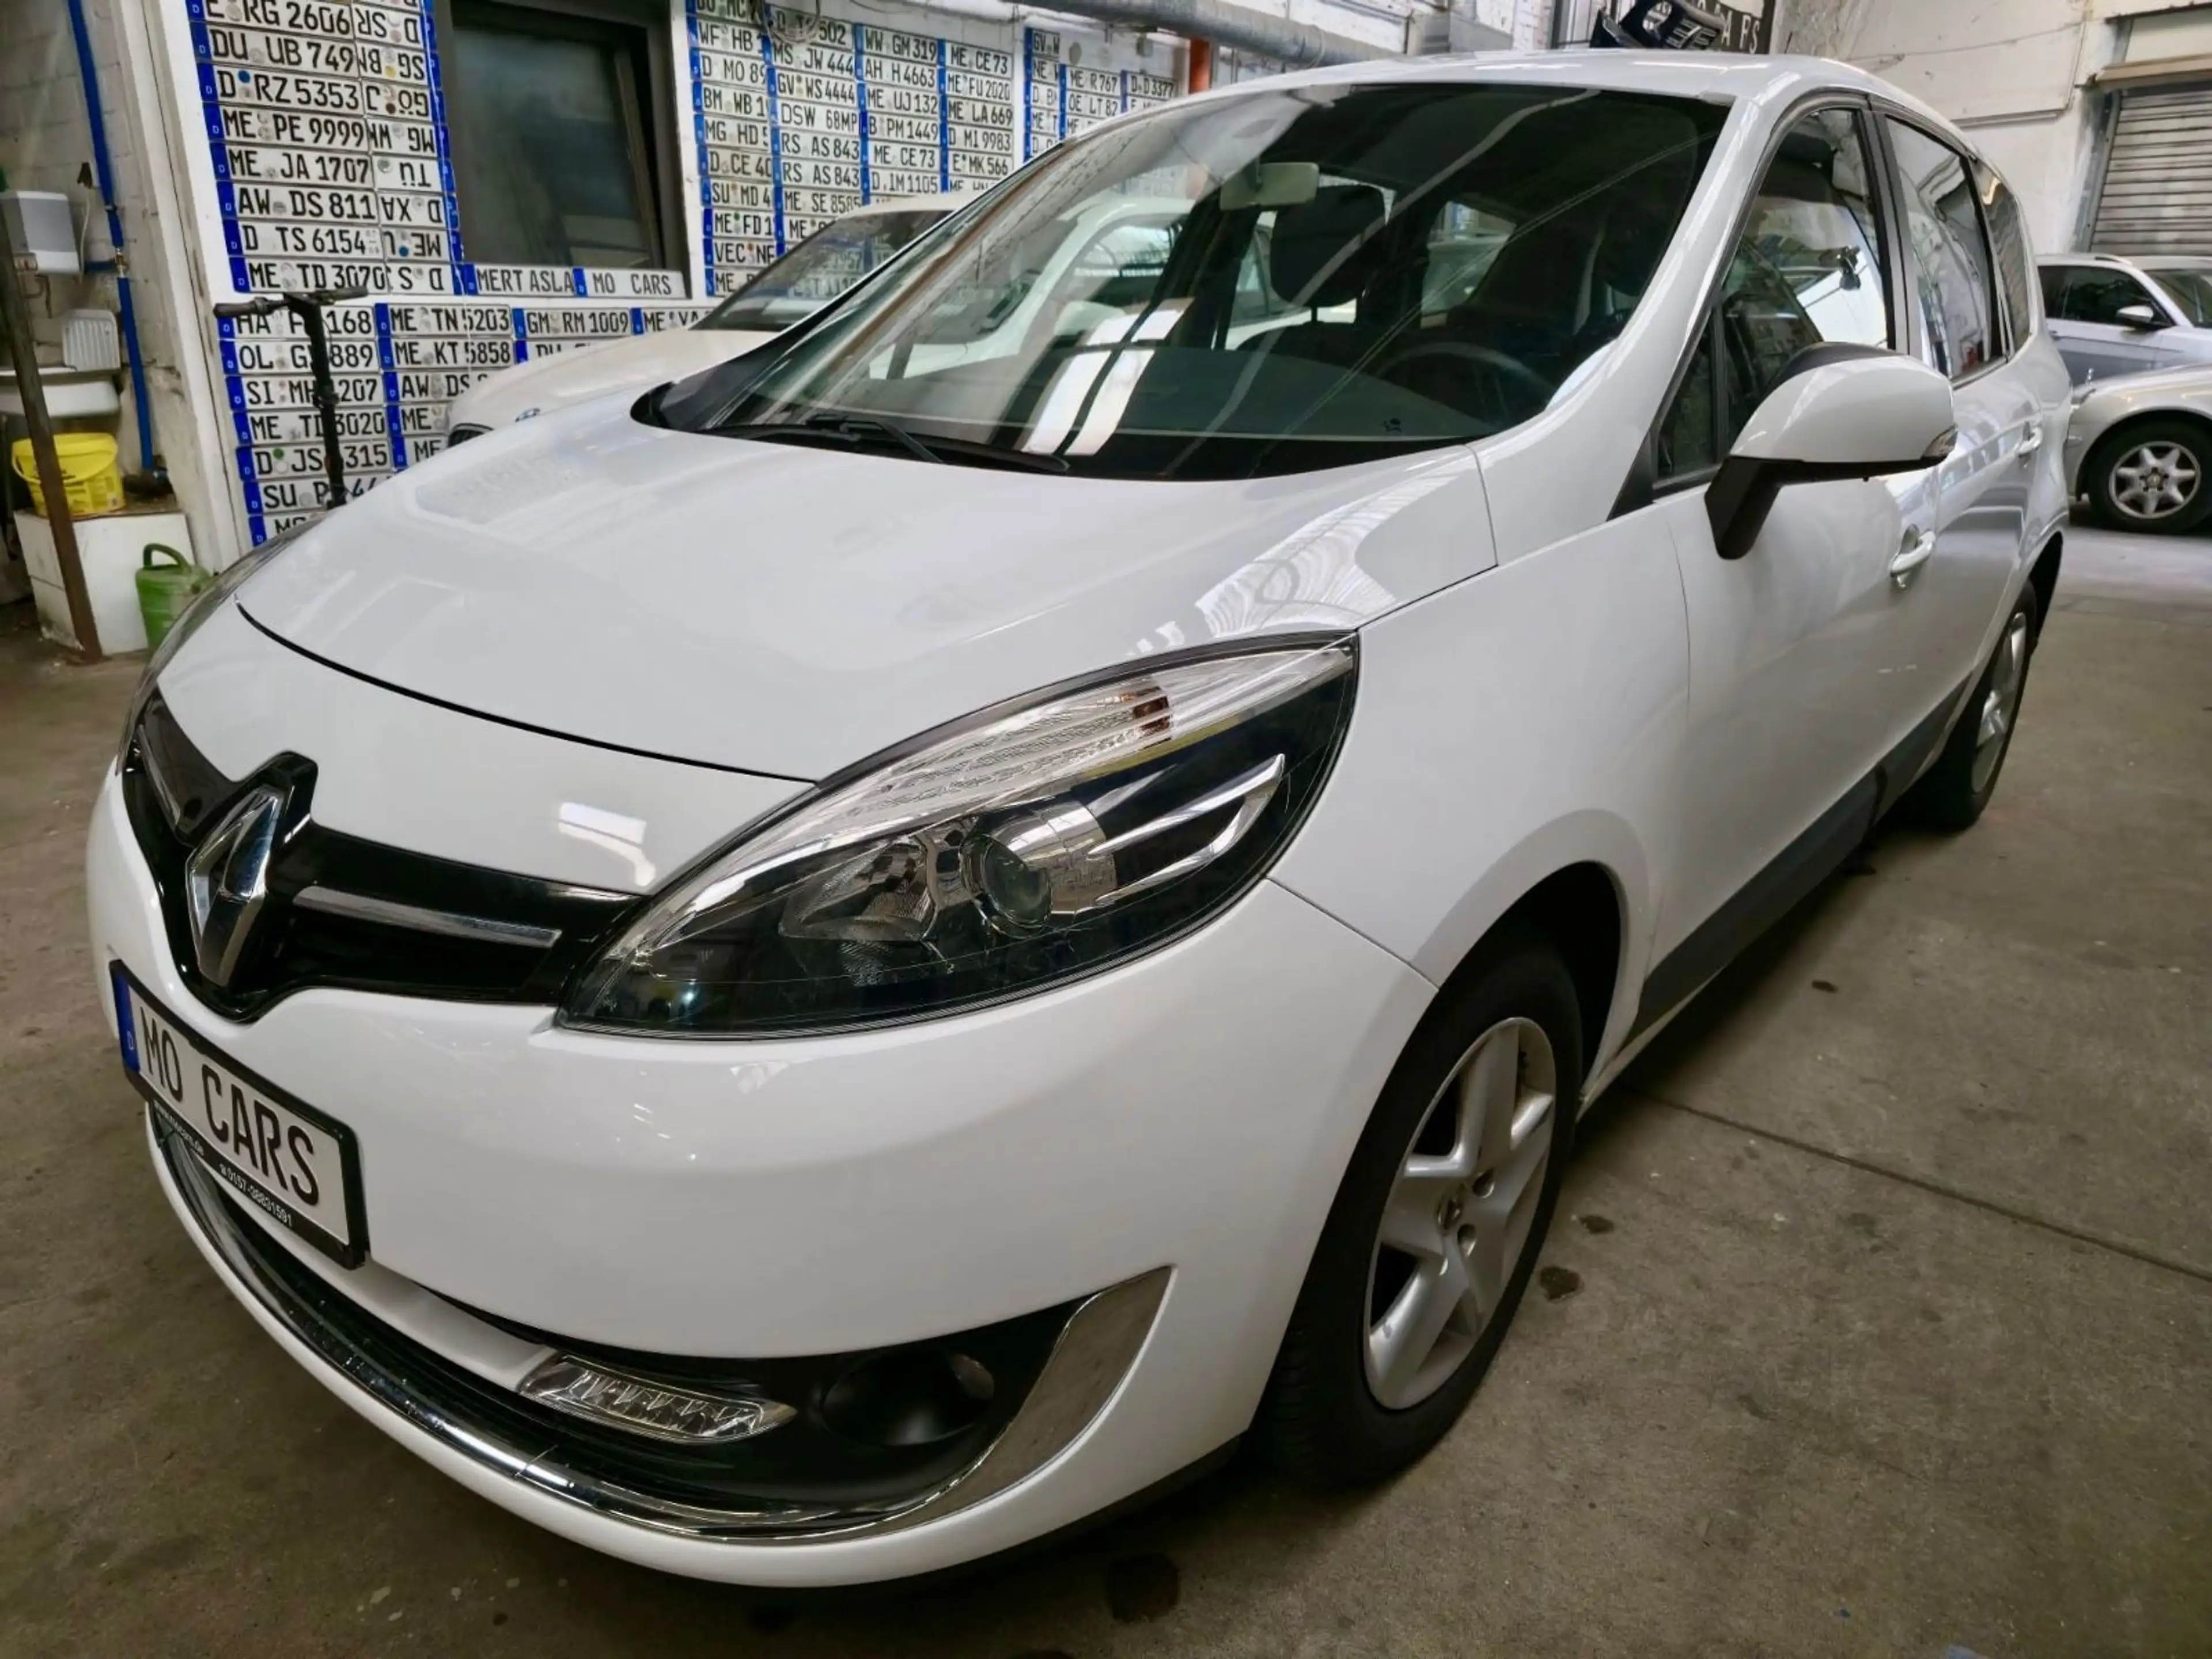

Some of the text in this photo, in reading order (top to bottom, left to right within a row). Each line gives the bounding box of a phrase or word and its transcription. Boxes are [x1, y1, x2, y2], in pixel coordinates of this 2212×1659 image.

[244, 0, 279, 25] RG
[286, 2, 350, 35] 2606
[699, 23, 719, 45] WF
[732, 28, 753, 51] HB
[866, 29, 937, 60] WW GM 319
[209, 29, 353, 71] DU UB 749
[804, 48, 824, 71] JW
[951, 46, 1007, 74] ME CE 73
[702, 55, 745, 81] D MO
[865, 58, 882, 79] AH
[904, 65, 935, 88] 4663
[217, 70, 359, 109] D RZ 5353
[778, 73, 855, 104] GV WS 4444
[948, 73, 961, 93] ME
[703, 87, 752, 114] BM WB
[868, 88, 938, 114] ME UJ 132
[948, 99, 1013, 126] ME LA 669
[781, 103, 816, 127] DSW
[223, 109, 363, 147] ME PE 9999
[704, 119, 759, 145] MG HD
[869, 116, 938, 141] B PM 1449
[964, 129, 978, 147] MI
[782, 133, 859, 160] RS AS 843
[874, 144, 935, 168] ME CE 73
[229, 150, 368, 183] ME JA 1707
[710, 151, 719, 172] D
[731, 153, 751, 176] CE
[782, 162, 859, 187] RS AS 843
[712, 183, 730, 203] SU
[740, 185, 759, 206] MD
[872, 172, 880, 190] D
[907, 175, 938, 194] 1105
[238, 188, 375, 219] AW DS 811
[785, 191, 801, 211] ME
[812, 192, 827, 213] SE
[715, 213, 733, 233] ME
[743, 214, 762, 235] FD
[789, 219, 807, 238] ME
[242, 225, 258, 251] D
[275, 226, 306, 252] TS
[313, 229, 365, 254] 6154
[714, 242, 746, 263] VEC
[249, 263, 385, 290] ME TD 3070
[477, 267, 523, 291] MERT
[592, 272, 672, 295] MO CARS
[715, 272, 737, 293] ME
[326, 310, 372, 335] 168
[389, 308, 509, 332] ME TN 5203
[527, 312, 628, 334] GM RM 1009
[643, 311, 666, 332] ME
[239, 344, 373, 369] OL 889
[394, 341, 422, 365] ME
[434, 342, 459, 365] KT
[464, 342, 511, 364] 5858
[247, 380, 275, 404] SI
[338, 378, 377, 402] 207
[402, 375, 430, 399] AW
[250, 412, 385, 440] ME 3020
[401, 408, 431, 431] ME
[254, 444, 388, 475] D JS 315
[263, 483, 298, 509] SU
[140, 1006, 183, 1102] MO
[202, 1064, 319, 1206] CARS
